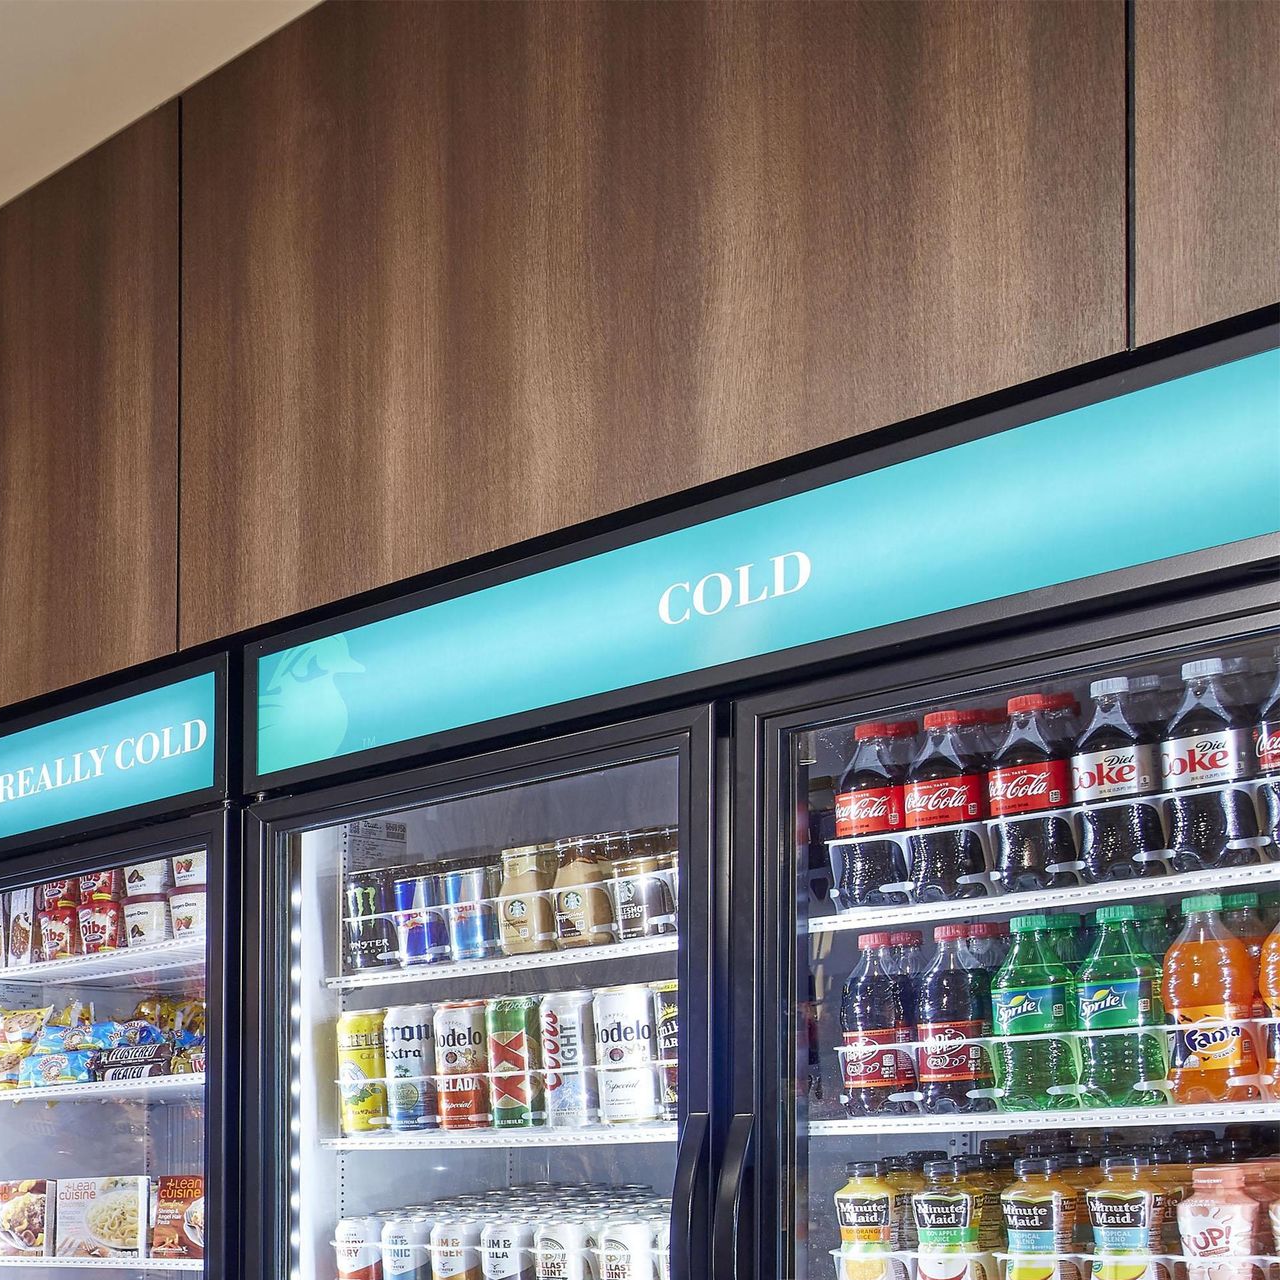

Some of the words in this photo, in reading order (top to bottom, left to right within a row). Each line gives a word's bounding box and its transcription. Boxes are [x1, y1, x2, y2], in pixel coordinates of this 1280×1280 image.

[658, 551, 811, 625] COLD
[115, 719, 207, 770] COLD
[1196, 740, 1227, 752] Diet
[1104, 754, 1133, 766] Diet
[1161, 749, 1229, 778] Coke
[1072, 762, 1136, 791] Coke
[82, 921, 107, 936] Dibs
[998, 1001, 1038, 1021] Sprite
[1080, 994, 1122, 1016] Sprite
[1184, 1025, 1241, 1052] Fanta
[840, 1202, 885, 1214] Minute
[917, 1203, 965, 1214] Minute
[1002, 1204, 1048, 1216] Minute
[1090, 1201, 1138, 1213] Minute
[845, 1211, 881, 1223] Maid
[924, 1213, 958, 1225] Maid
[1008, 1214, 1043, 1226] Maid
[1096, 1213, 1135, 1225] Maid
[1182, 1225, 1232, 1257] YUP!
